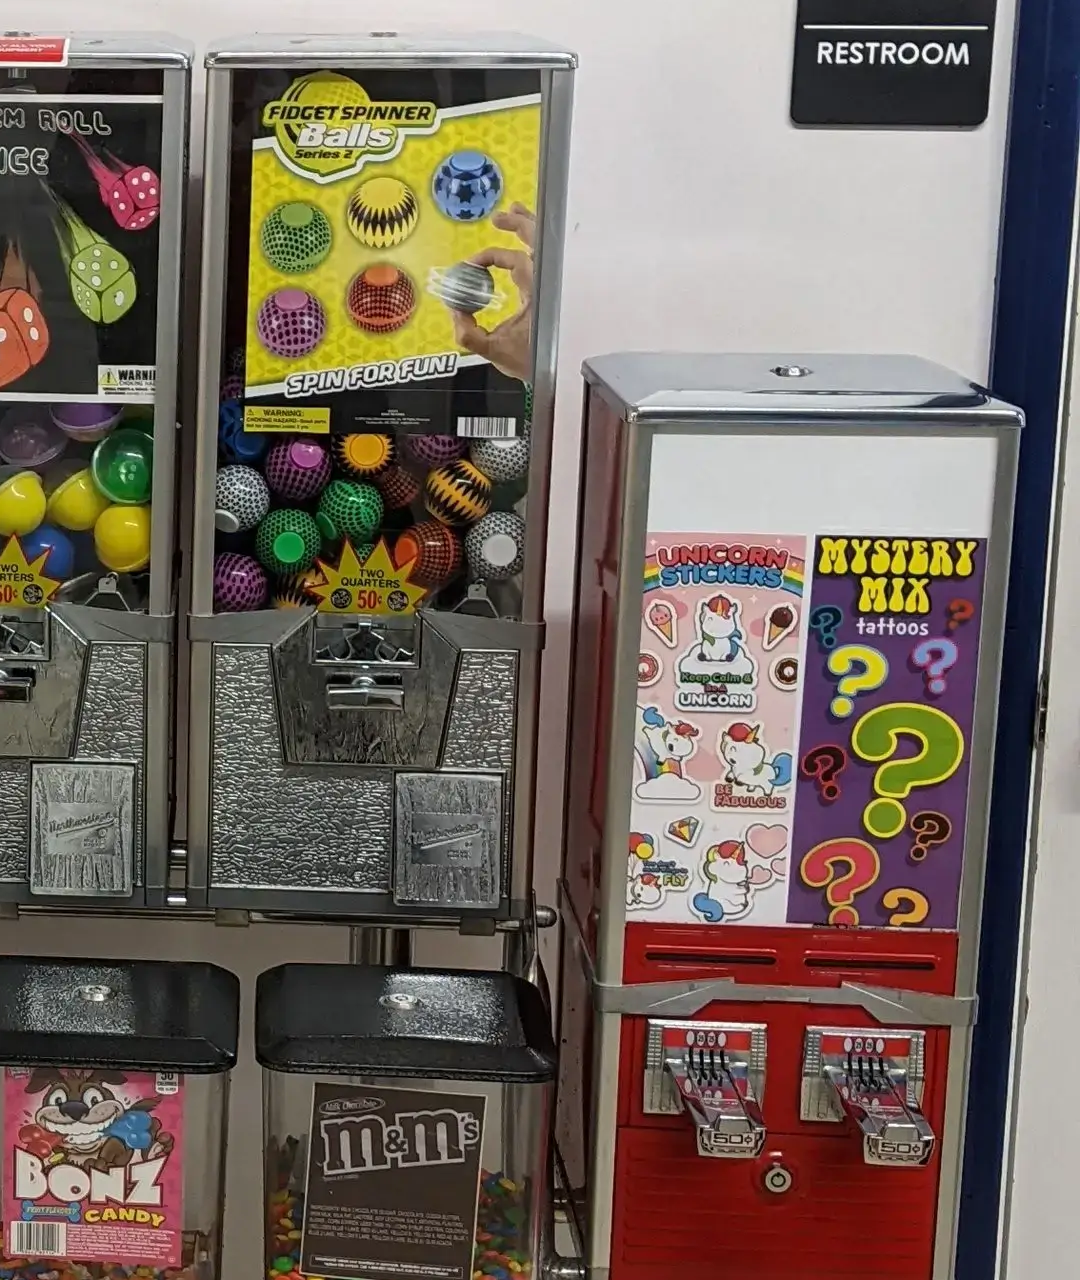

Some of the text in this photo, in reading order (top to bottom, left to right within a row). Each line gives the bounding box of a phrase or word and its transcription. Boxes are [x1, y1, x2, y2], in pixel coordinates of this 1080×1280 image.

[817, 42, 970, 65] RESTROOM
[269, 106, 431, 120] FIDGET SPINNER
[38, 109, 112, 135] ROLL
[297, 122, 394, 147] Balls
[295, 149, 353, 159] Series 2
[287, 353, 459, 395] SPIN FOR FUN!
[263, 409, 305, 417] WARNING:
[658, 544, 788, 569] UNICORN
[819, 538, 977, 576] MYSTERY
[359, 569, 384, 578] TWO
[660, 564, 783, 587] STICKERS
[341, 577, 400, 588] QUARTERS
[858, 576, 930, 613] MIX
[856, 617, 929, 636] tattoos
[680, 673, 711, 684] Keep
[712, 672, 742, 683] Calm
[680, 693, 753, 708] UNICORN
[715, 784, 733, 795] BE
[714, 795, 787, 808] FABULOUS
[663, 874, 689, 886] FLY
[325, 1102, 341, 1111] Milk
[14, 1145, 168, 1207] BONZ
[85, 1208, 166, 1227] CANDY
